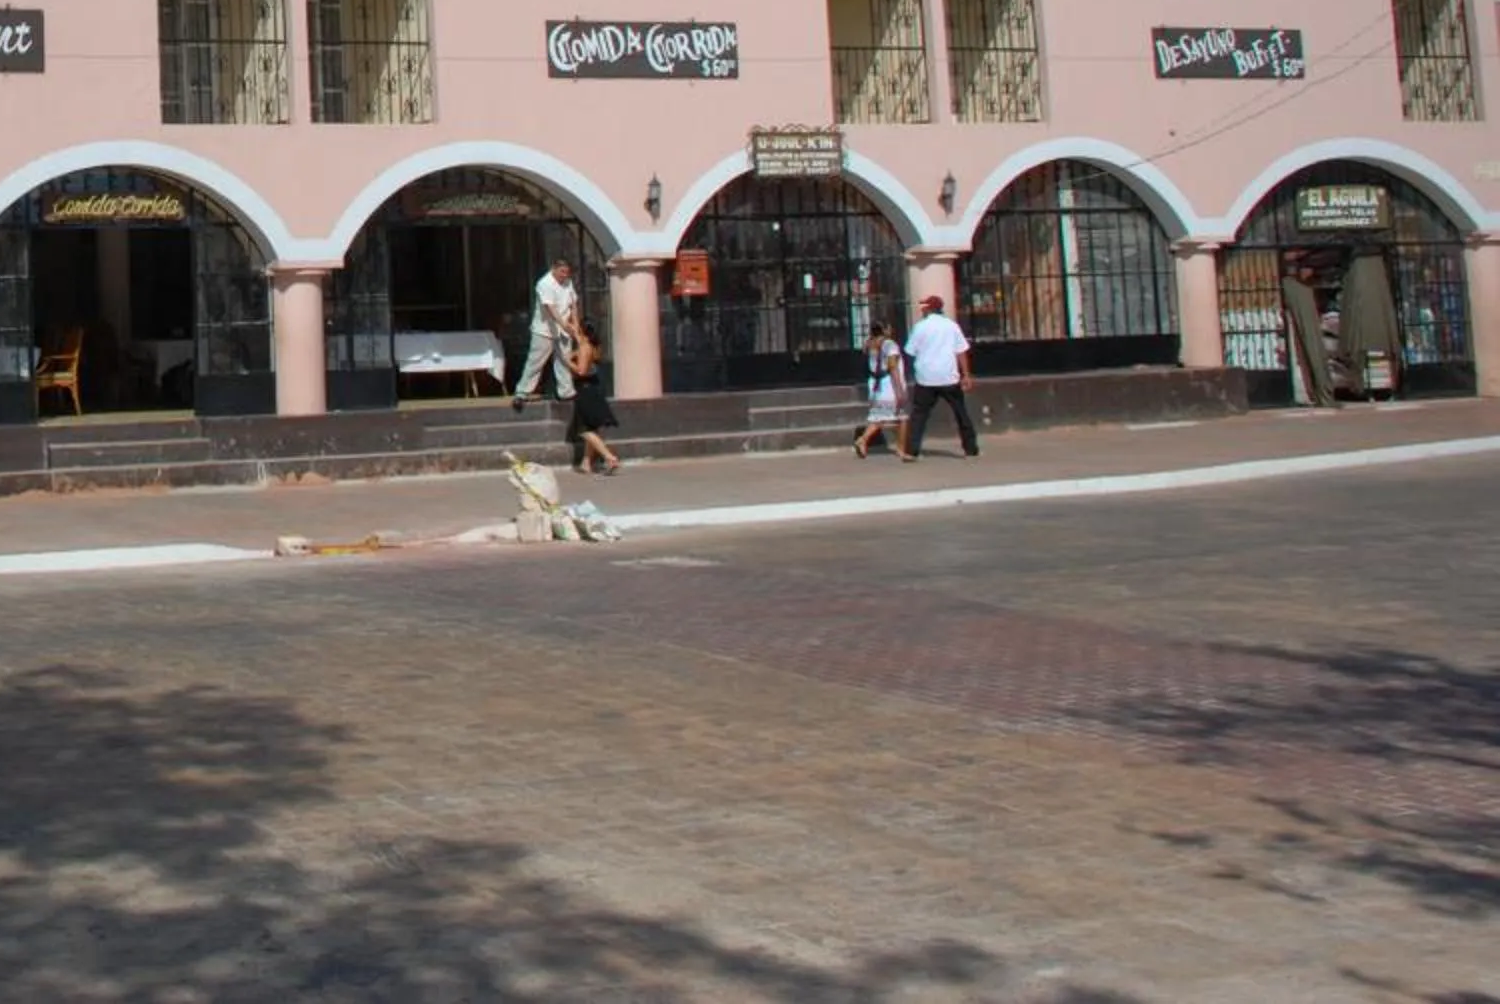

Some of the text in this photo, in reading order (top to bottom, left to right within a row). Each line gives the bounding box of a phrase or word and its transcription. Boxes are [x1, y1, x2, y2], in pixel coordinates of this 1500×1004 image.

[549, 23, 737, 74] COMIDA CORRIDA
[1156, 29, 1236, 74] DESAYUNO
